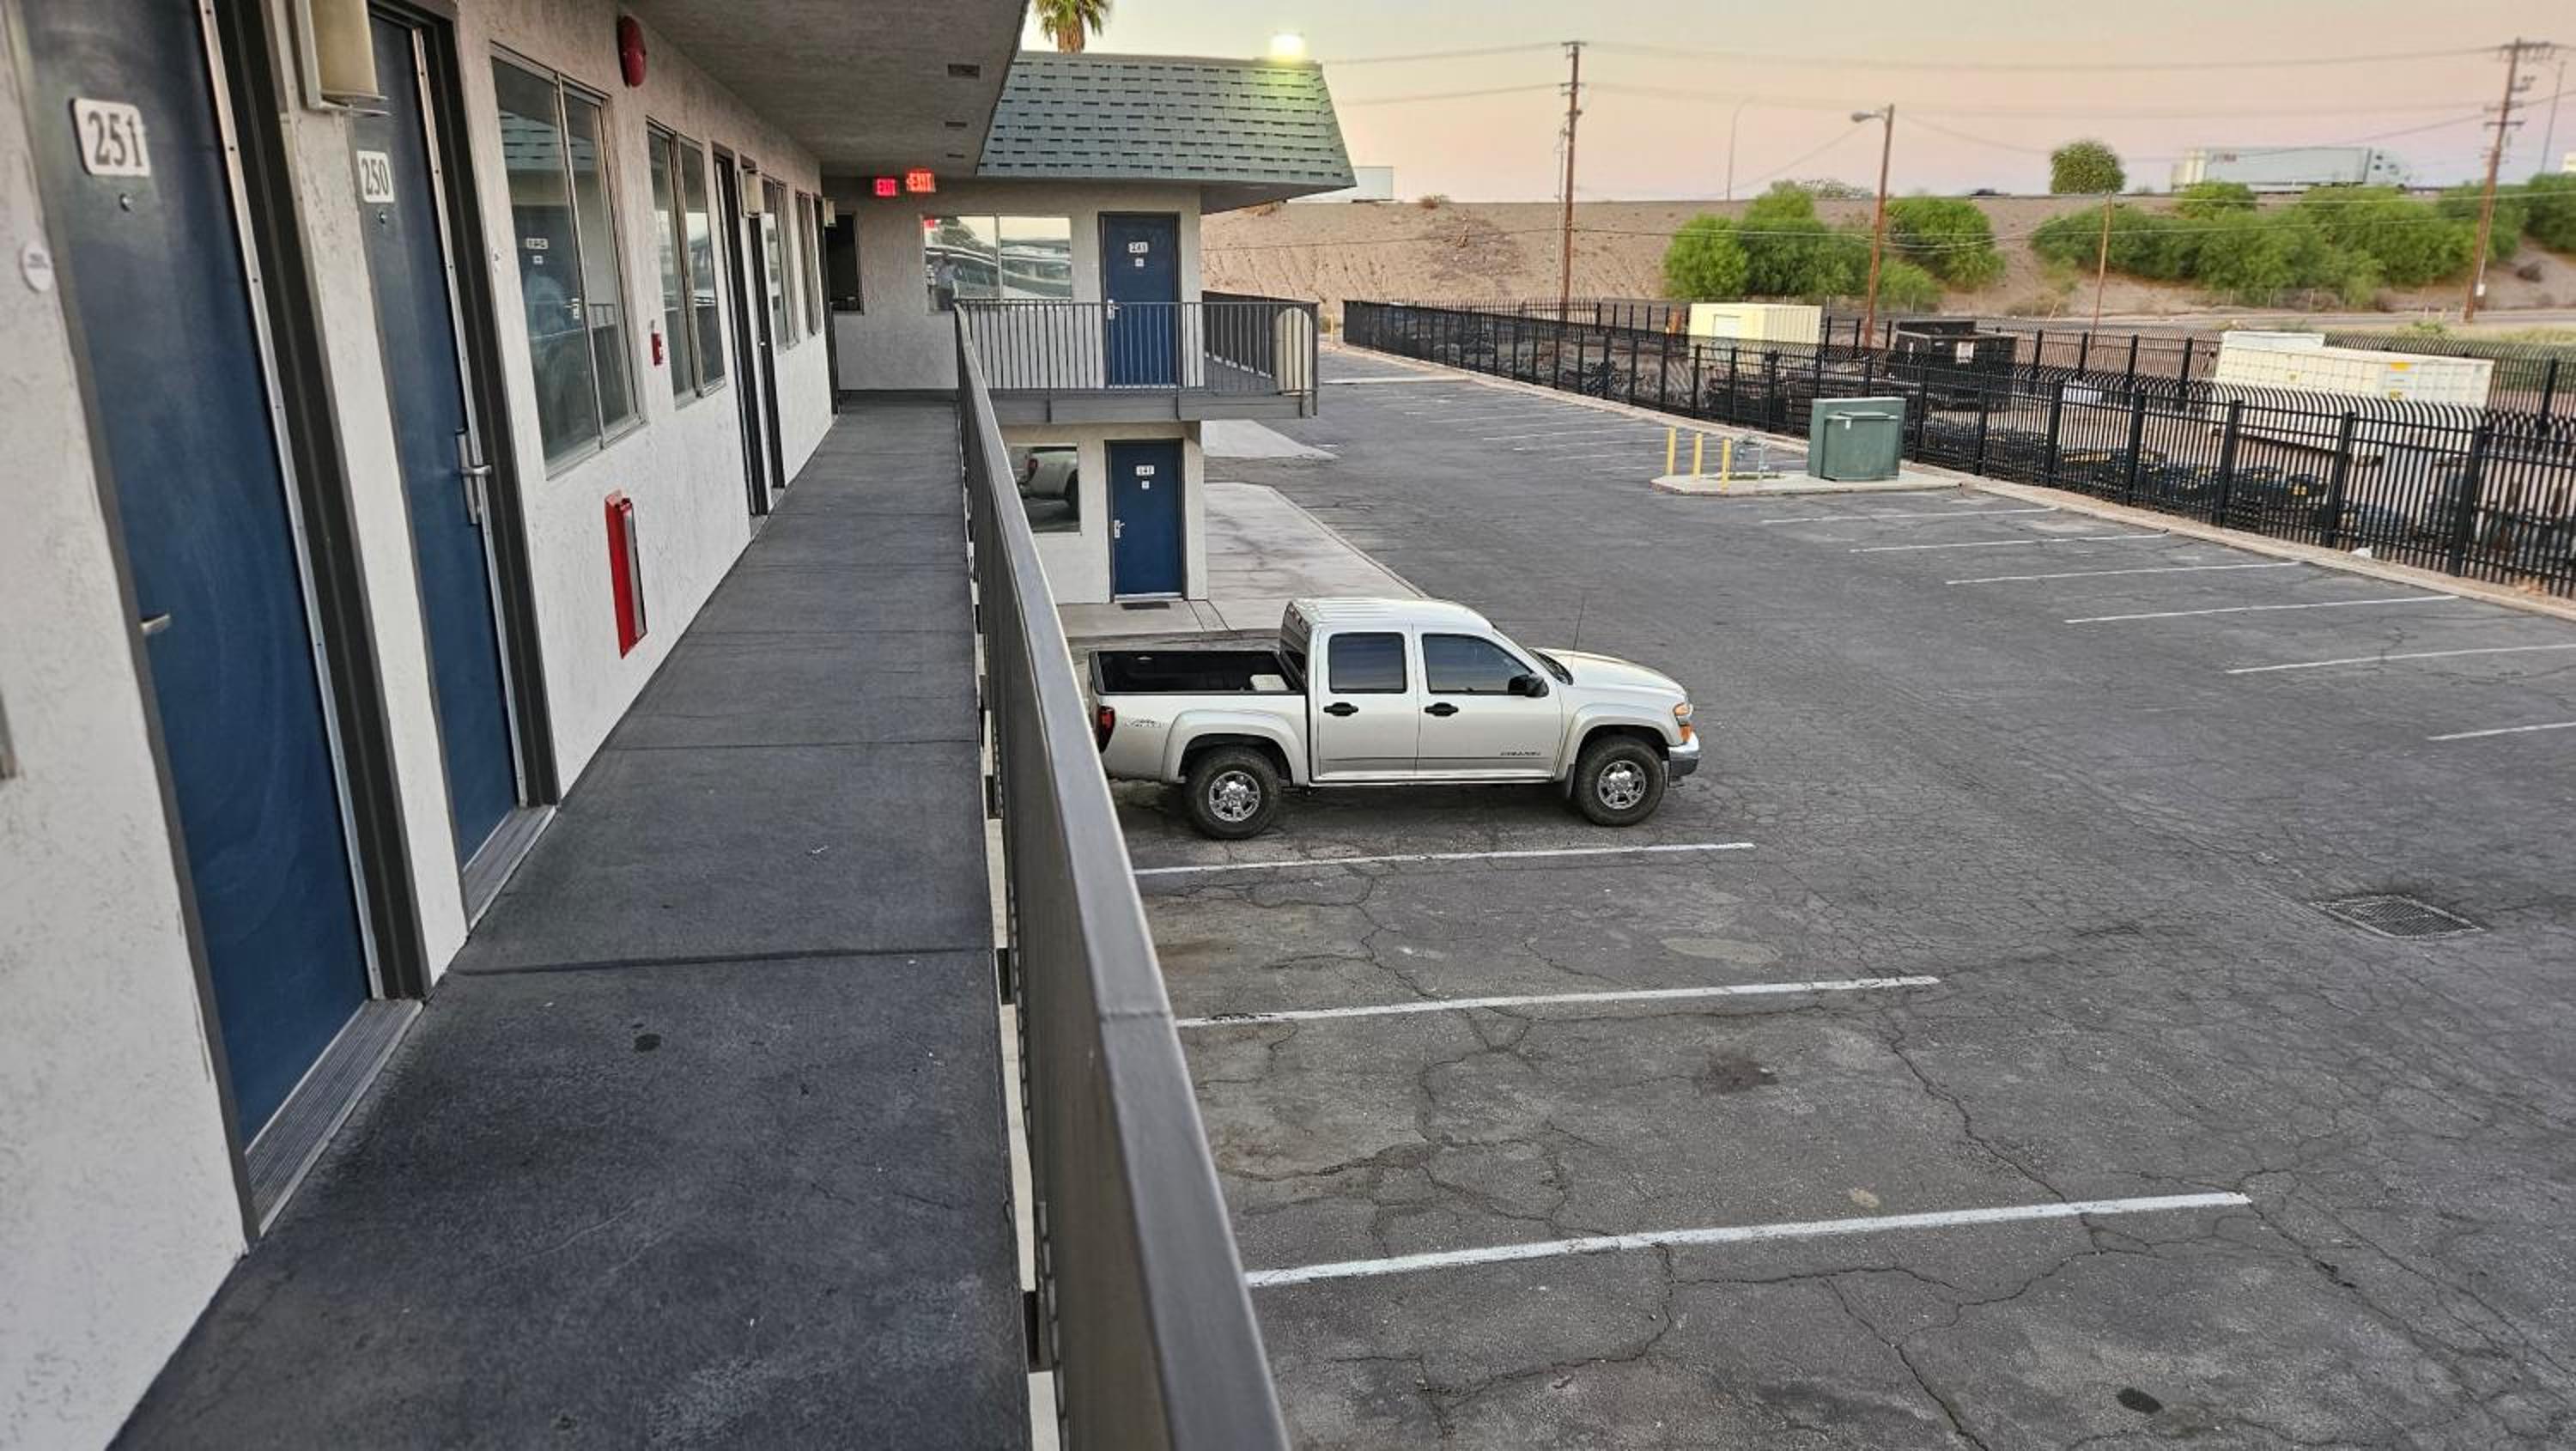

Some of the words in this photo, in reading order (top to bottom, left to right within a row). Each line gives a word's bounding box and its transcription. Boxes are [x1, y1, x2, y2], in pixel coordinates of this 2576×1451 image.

[88, 110, 143, 167] 251
[361, 158, 390, 196] 250
[909, 172, 933, 192] EXIT
